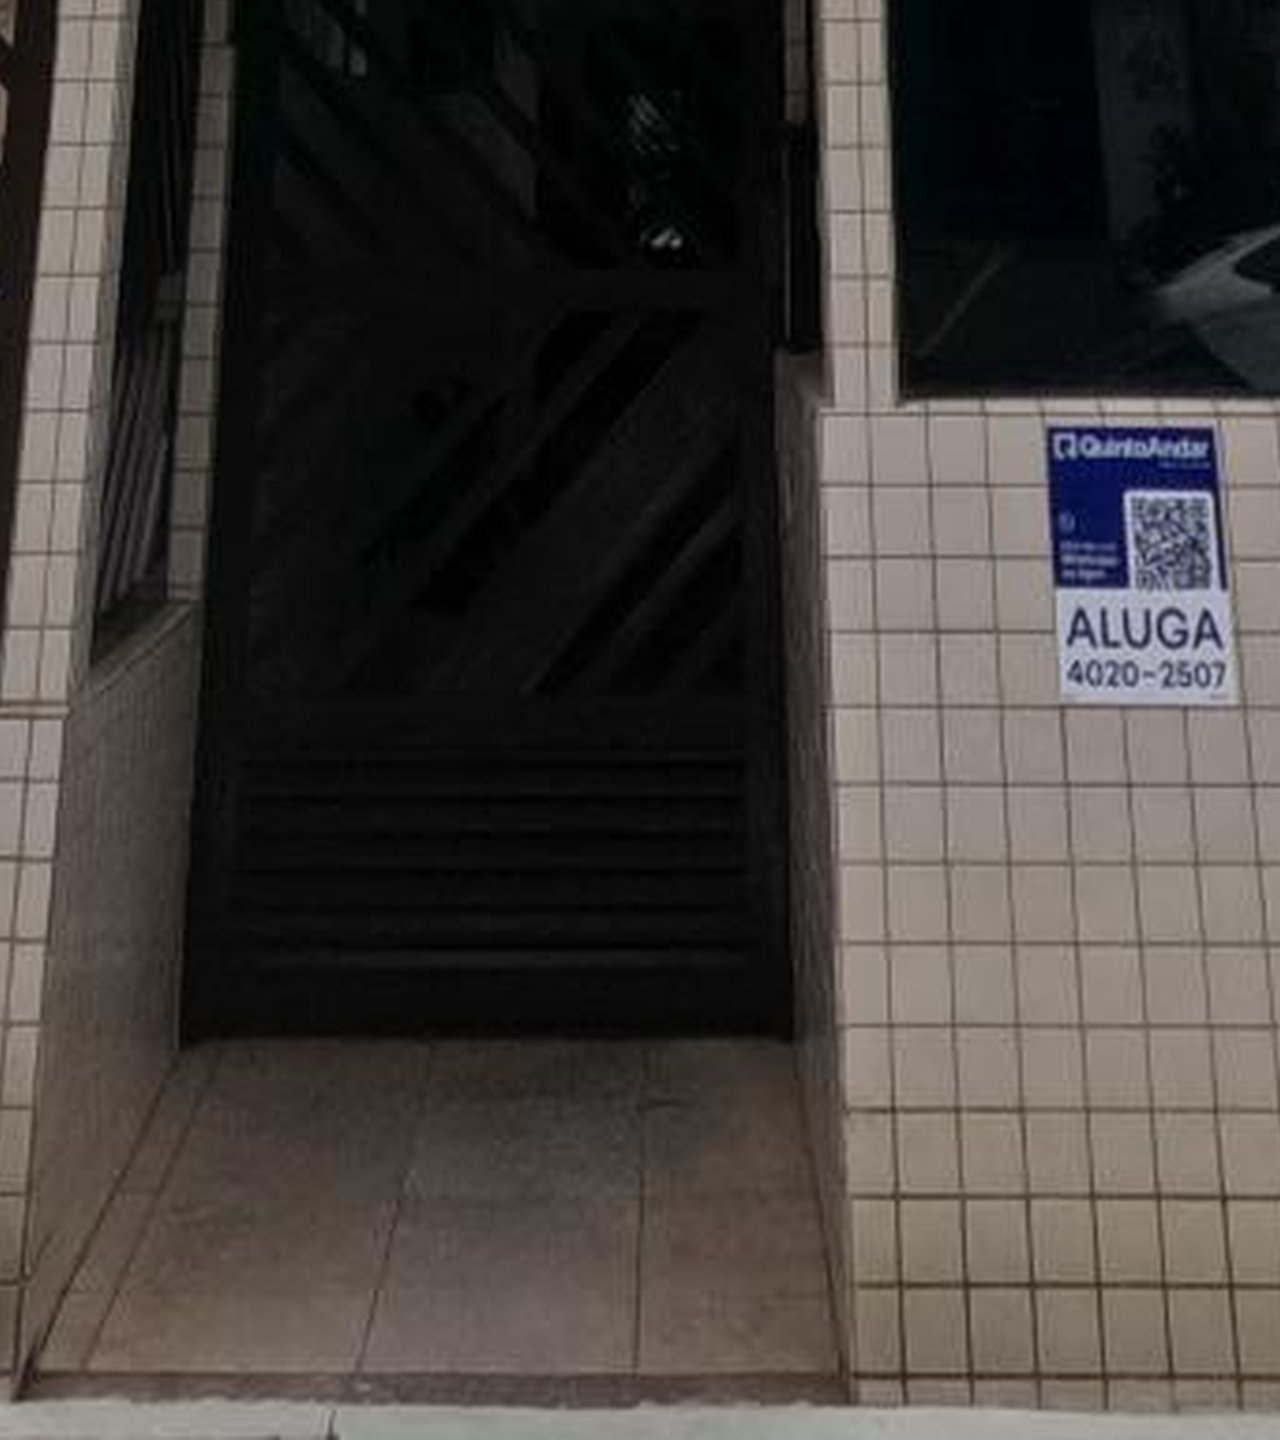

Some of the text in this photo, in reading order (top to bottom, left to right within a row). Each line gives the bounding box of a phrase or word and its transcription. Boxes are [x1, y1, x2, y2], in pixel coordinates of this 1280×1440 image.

[1080, 435, 1210, 459] QuintoAndar
[1067, 607, 1223, 650] ALUGA
[1067, 659, 1227, 689] 4020-2507
